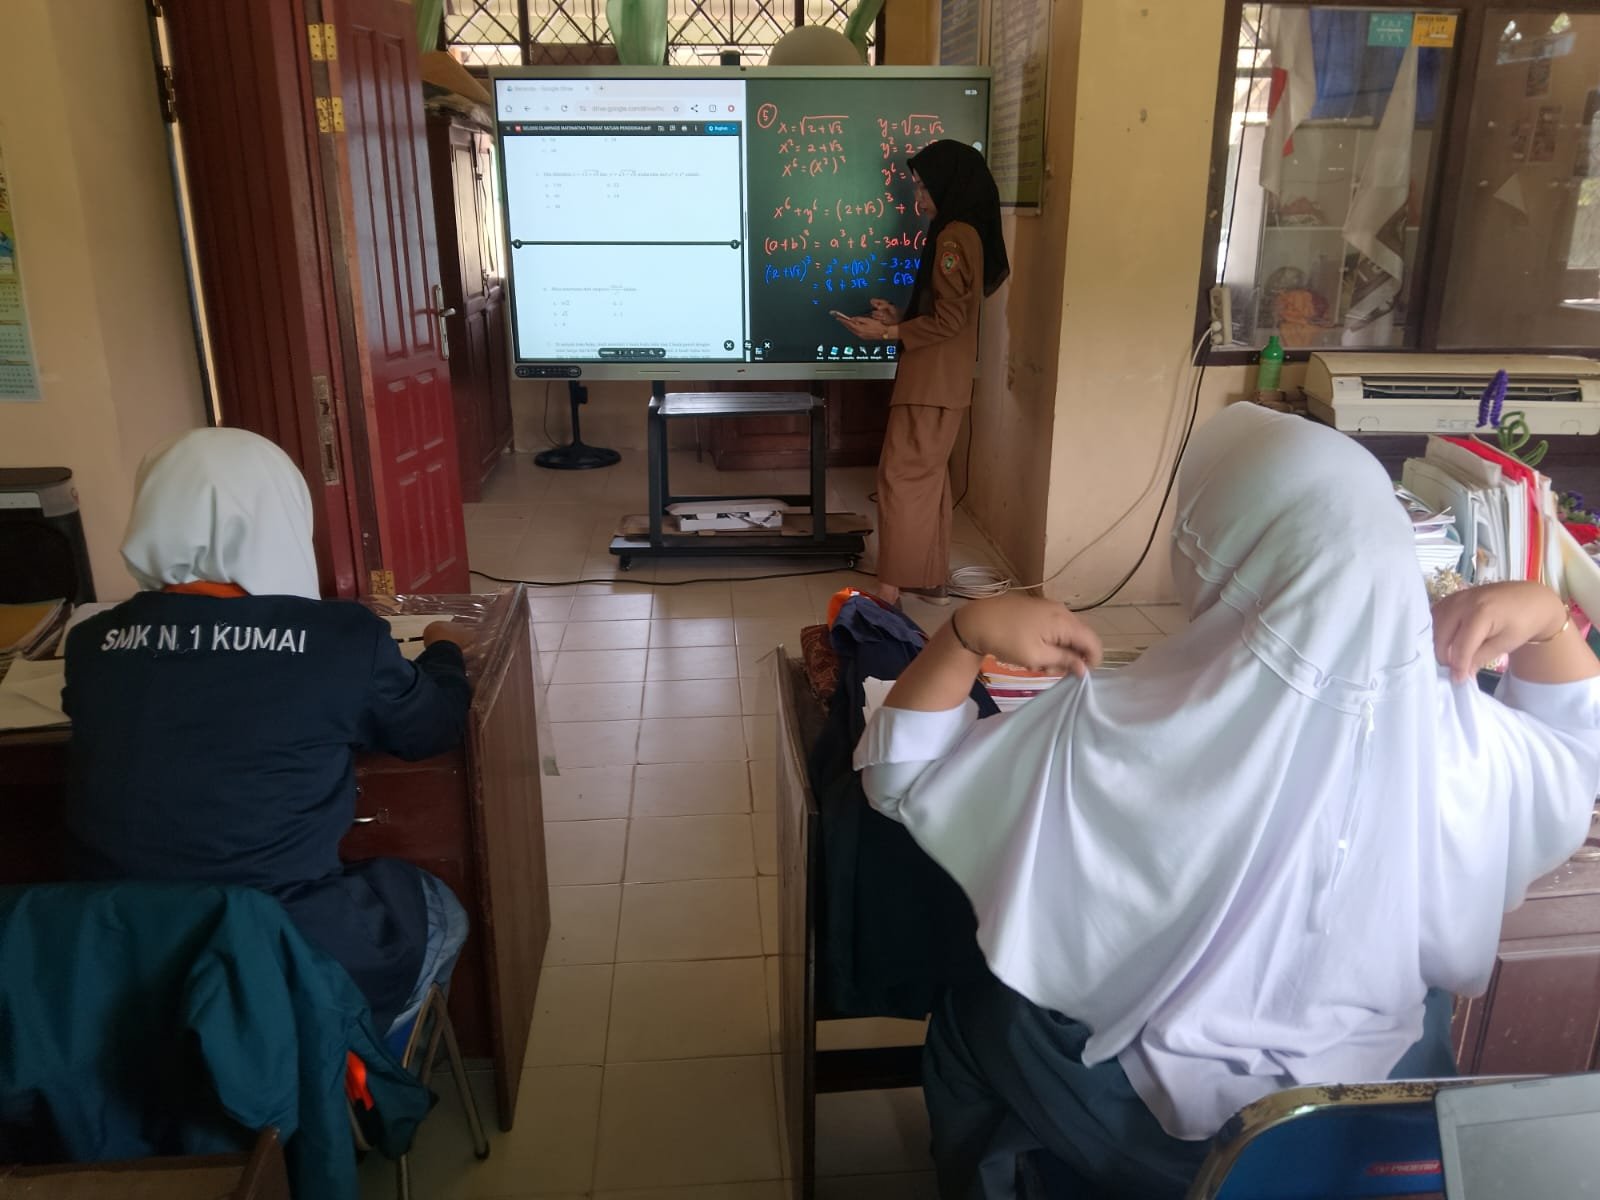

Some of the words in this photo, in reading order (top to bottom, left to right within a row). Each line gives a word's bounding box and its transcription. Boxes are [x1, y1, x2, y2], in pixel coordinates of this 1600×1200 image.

[101, 625, 151, 651] SMK
[157, 625, 178, 650] N
[190, 625, 200, 650] 1
[211, 625, 306, 653] KUMAI
